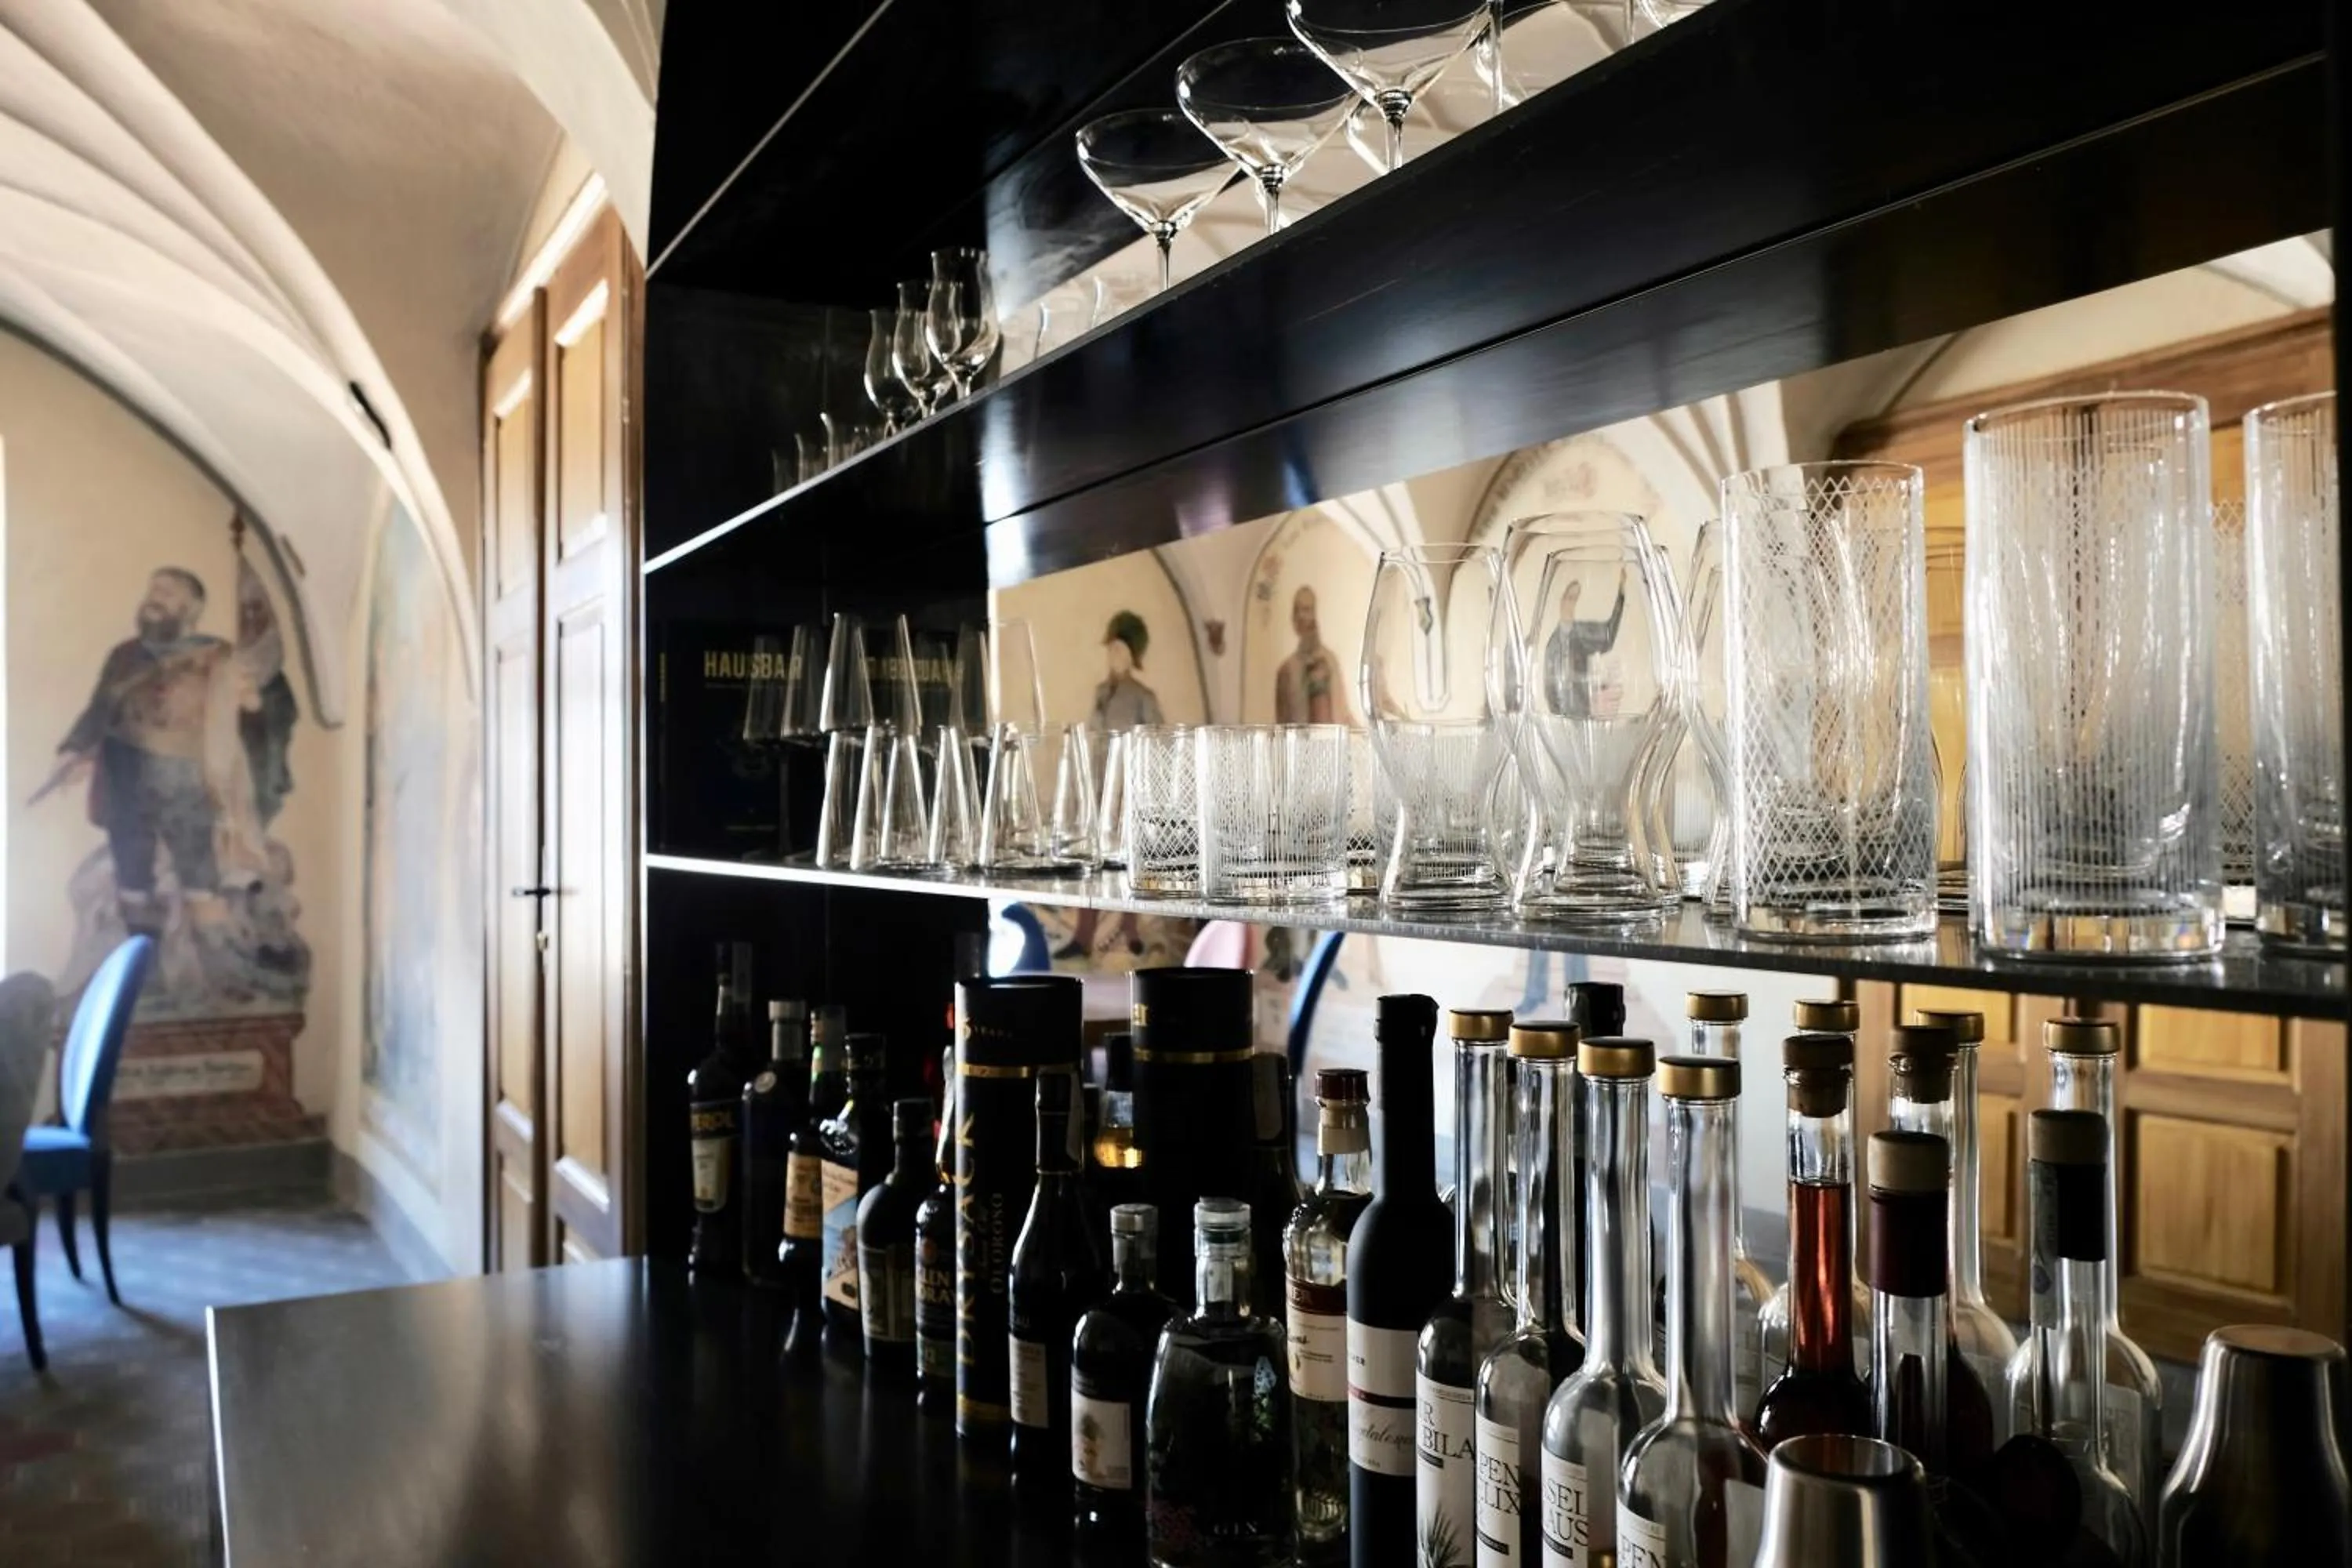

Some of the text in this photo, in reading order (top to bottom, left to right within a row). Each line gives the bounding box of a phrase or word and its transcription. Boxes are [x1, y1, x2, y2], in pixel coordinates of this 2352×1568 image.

[704, 650, 803, 681] HAUSBAR
[988, 1191, 1006, 1295] OLOROSO
[1213, 1520, 1259, 1535] GIN
